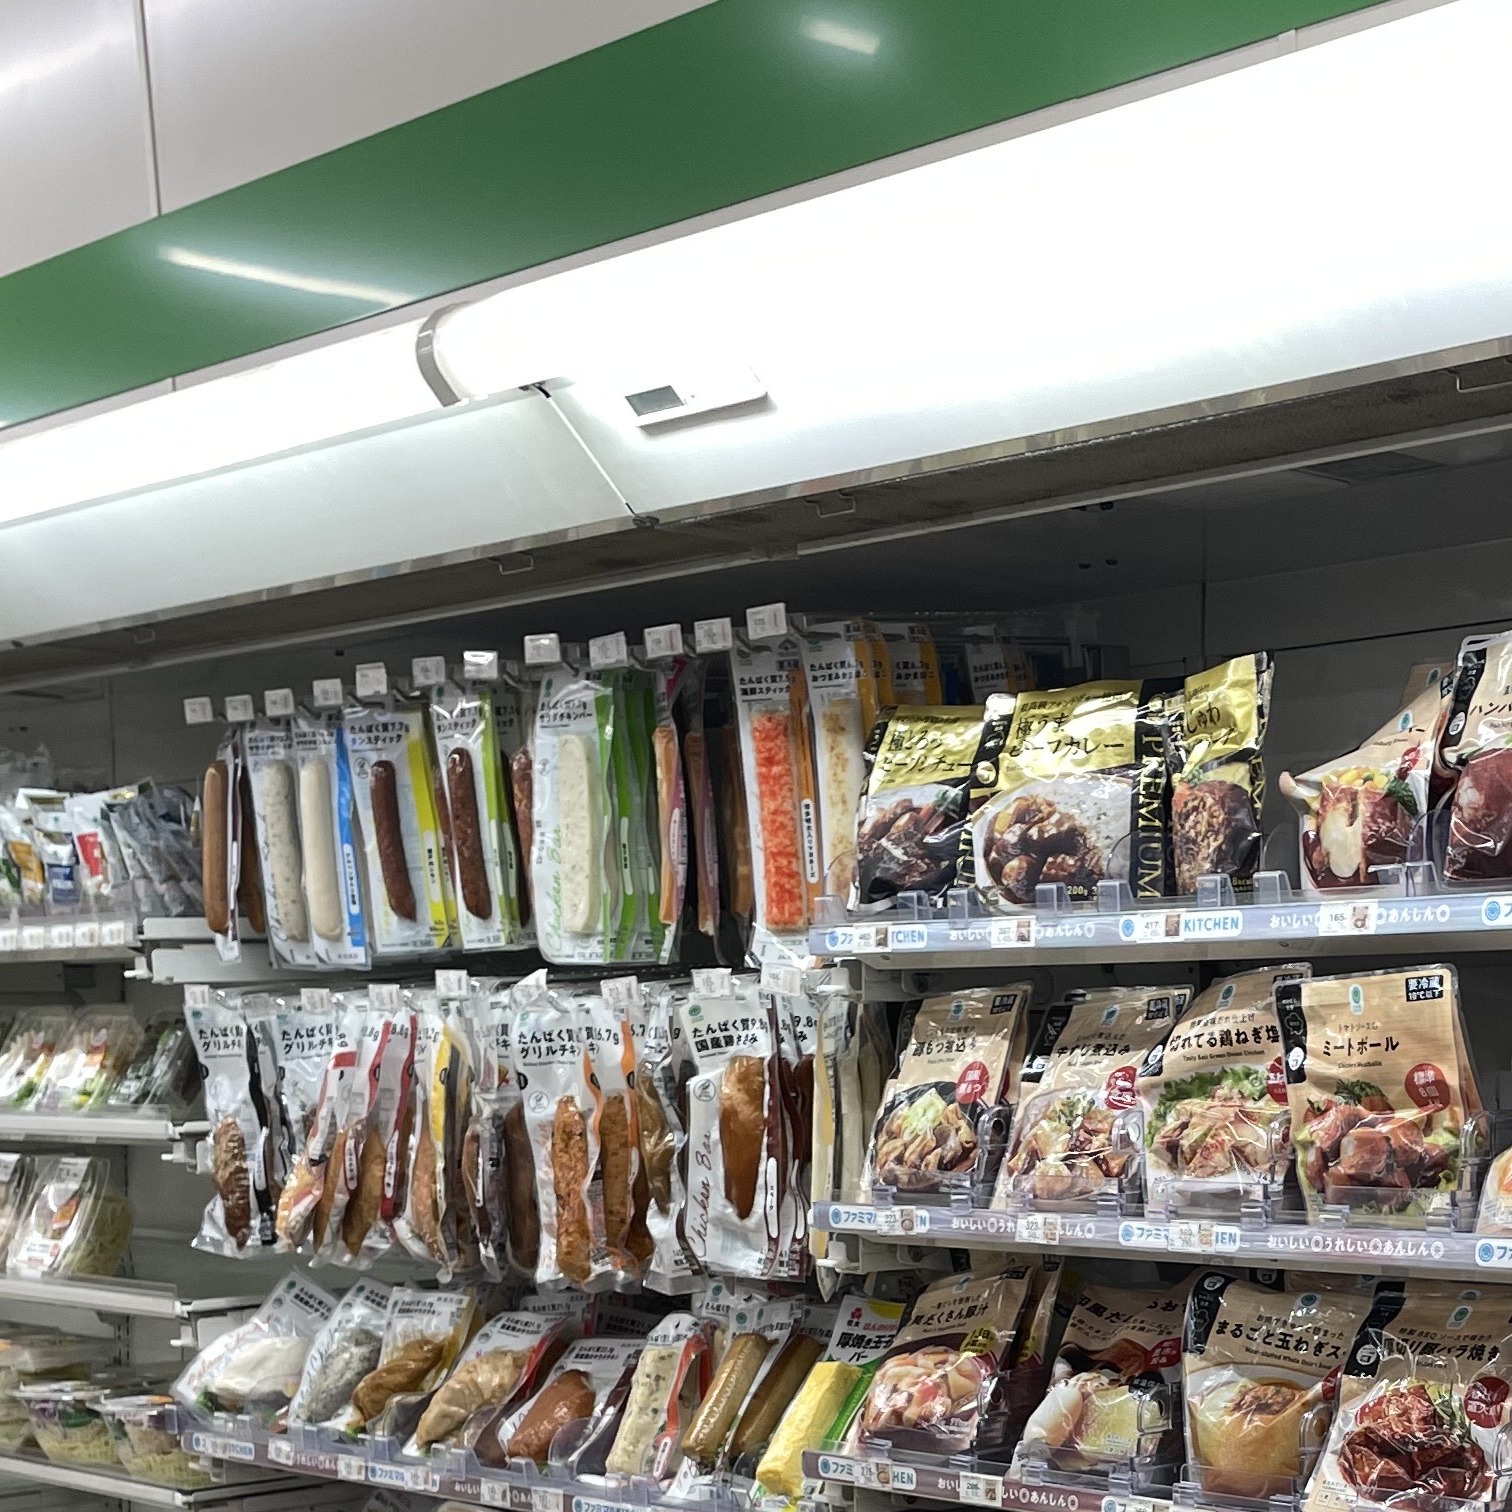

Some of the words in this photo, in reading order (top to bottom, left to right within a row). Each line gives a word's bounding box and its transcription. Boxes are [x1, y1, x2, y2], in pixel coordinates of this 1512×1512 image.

[1322, 1036, 1401, 1058] ミートボール
